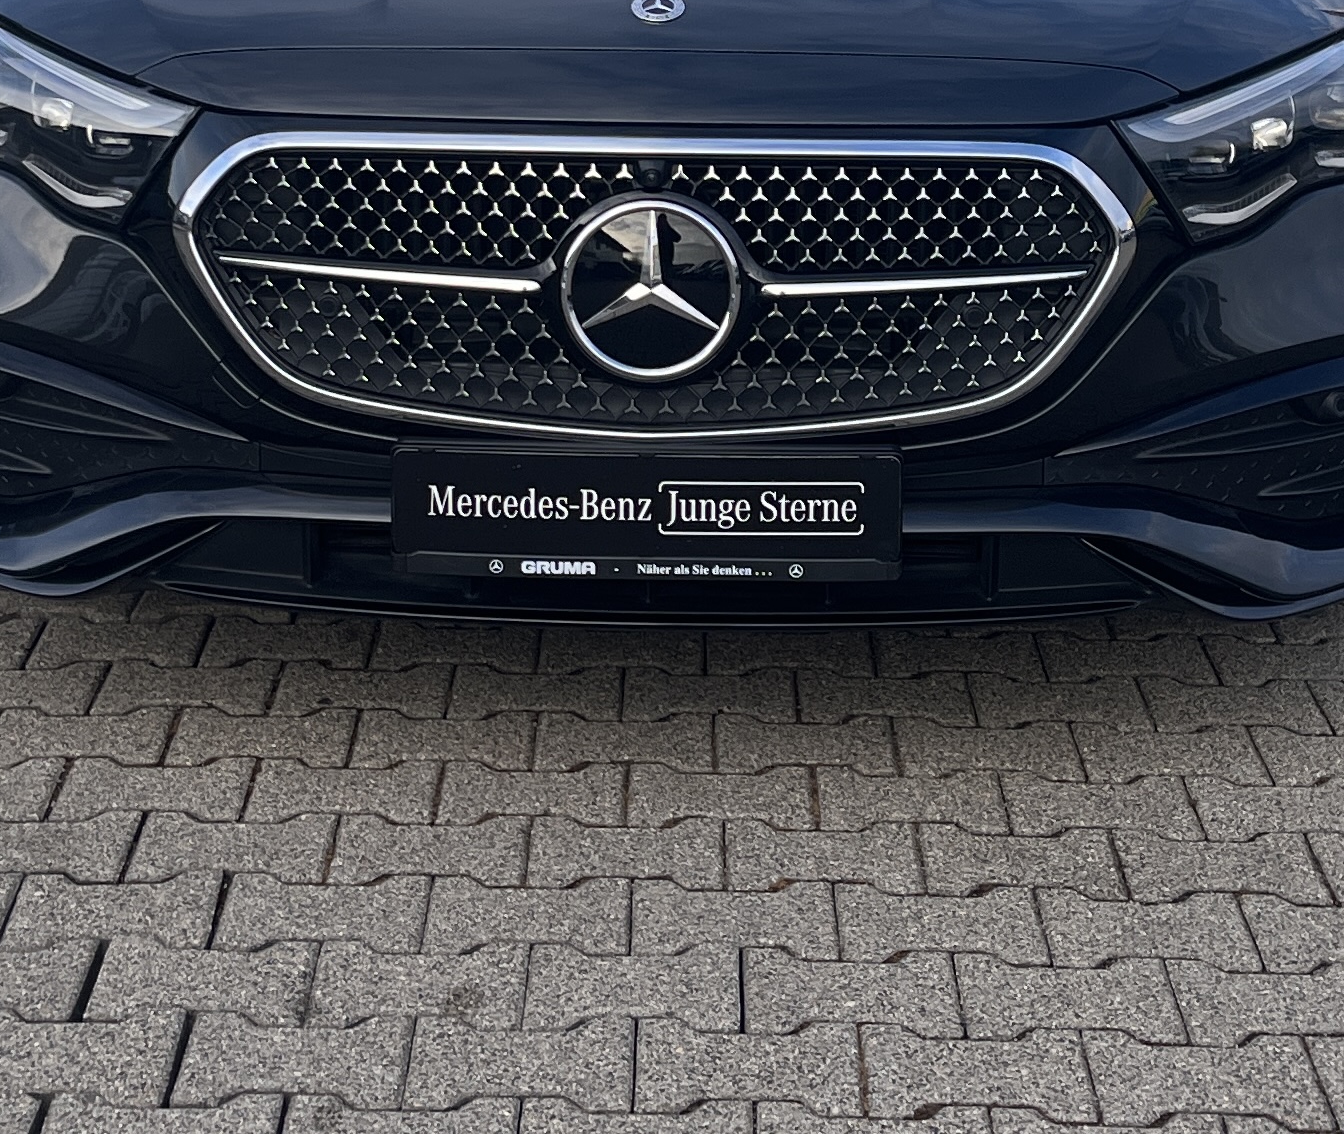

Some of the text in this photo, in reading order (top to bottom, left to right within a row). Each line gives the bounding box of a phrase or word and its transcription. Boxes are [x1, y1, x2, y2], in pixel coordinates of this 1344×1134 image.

[428, 483, 857, 529] Mercedes-Benz Junge Sterne
[520, 560, 596, 575] GRUMA
[636, 563, 672, 575] Näher
[673, 563, 690, 575] als
[692, 564, 710, 576] Sie
[711, 564, 753, 576] denken
